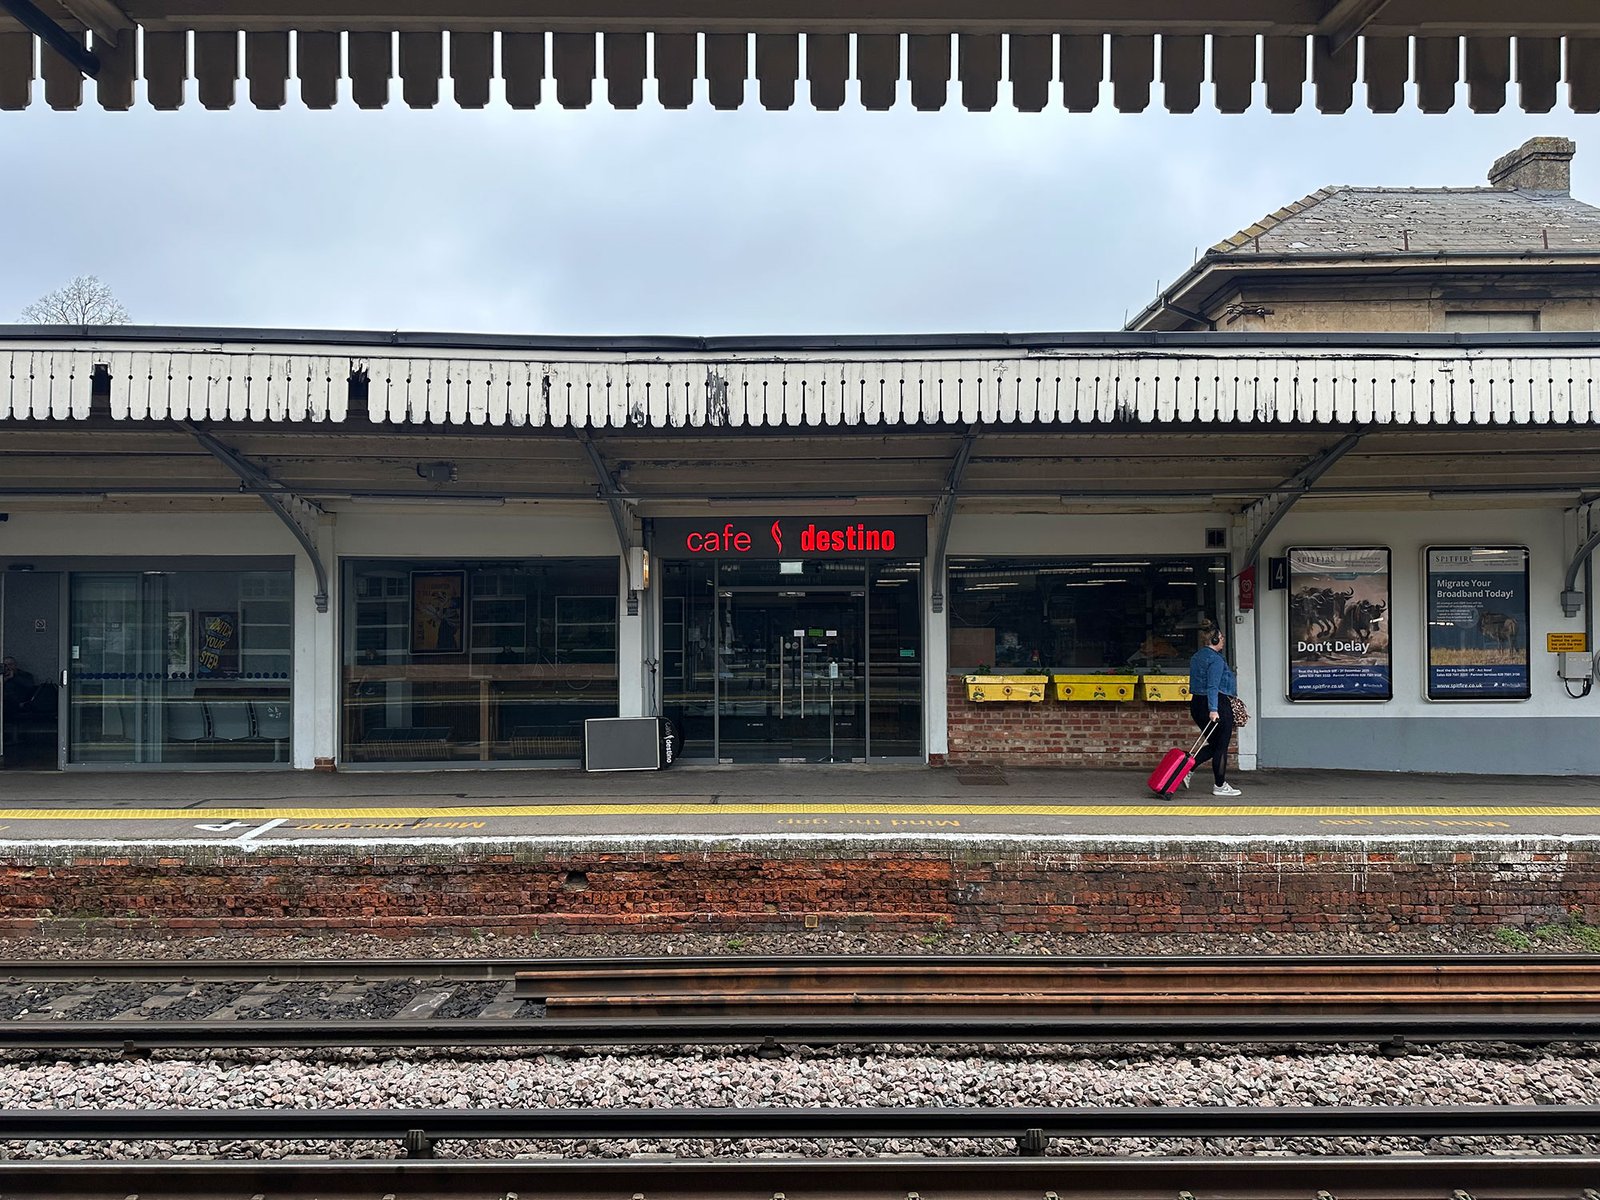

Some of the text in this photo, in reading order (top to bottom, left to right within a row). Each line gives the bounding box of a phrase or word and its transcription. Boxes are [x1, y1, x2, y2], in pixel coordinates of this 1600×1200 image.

[686, 523, 895, 552] cafe destino
[1276, 563, 1284, 584] 4
[1437, 579, 1492, 589] Migrate Your
[1437, 590, 1514, 600] Broadband Today!
[209, 617, 233, 638] WATCH
[205, 634, 226, 650] YOUR
[1297, 640, 1370, 655] Don't Delay
[199, 650, 219, 670] STEP
[665, 739, 673, 764] destino
[891, 819, 960, 827] Mind
